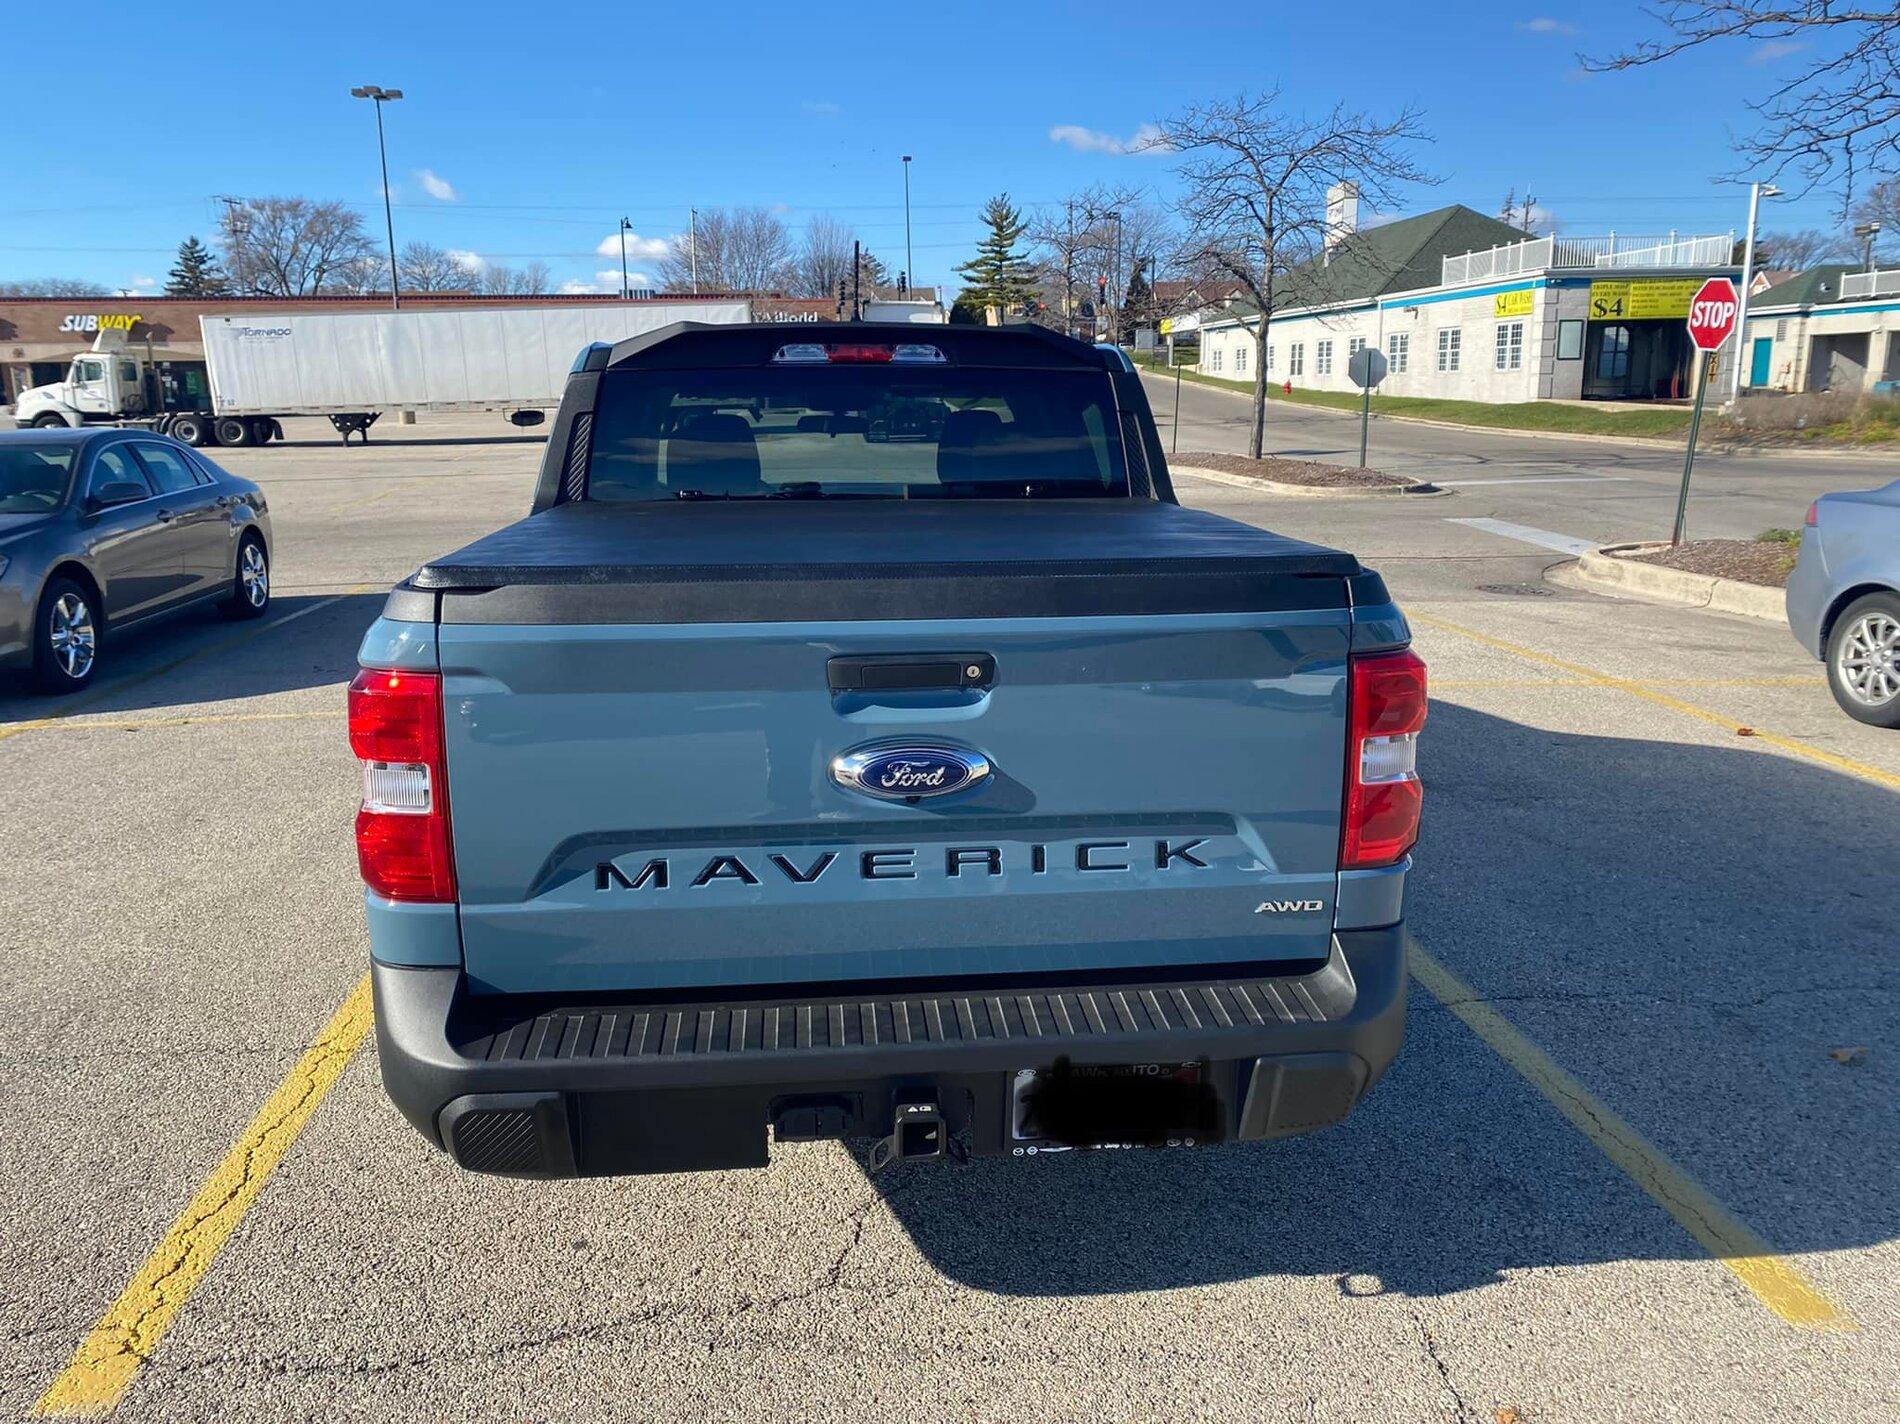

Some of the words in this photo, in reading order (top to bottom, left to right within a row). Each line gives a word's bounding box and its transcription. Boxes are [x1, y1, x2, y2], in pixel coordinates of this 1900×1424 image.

[1593, 297, 1623, 318] $4
[1691, 301, 1735, 328] STOP
[59, 314, 142, 332] SUBWAY
[243, 327, 292, 337] TORNADO
[1708, 356, 1718, 383] XIT
[881, 760, 946, 787] Ford
[595, 838, 1213, 891] MAVERICK
[1254, 900, 1323, 913] AWD
